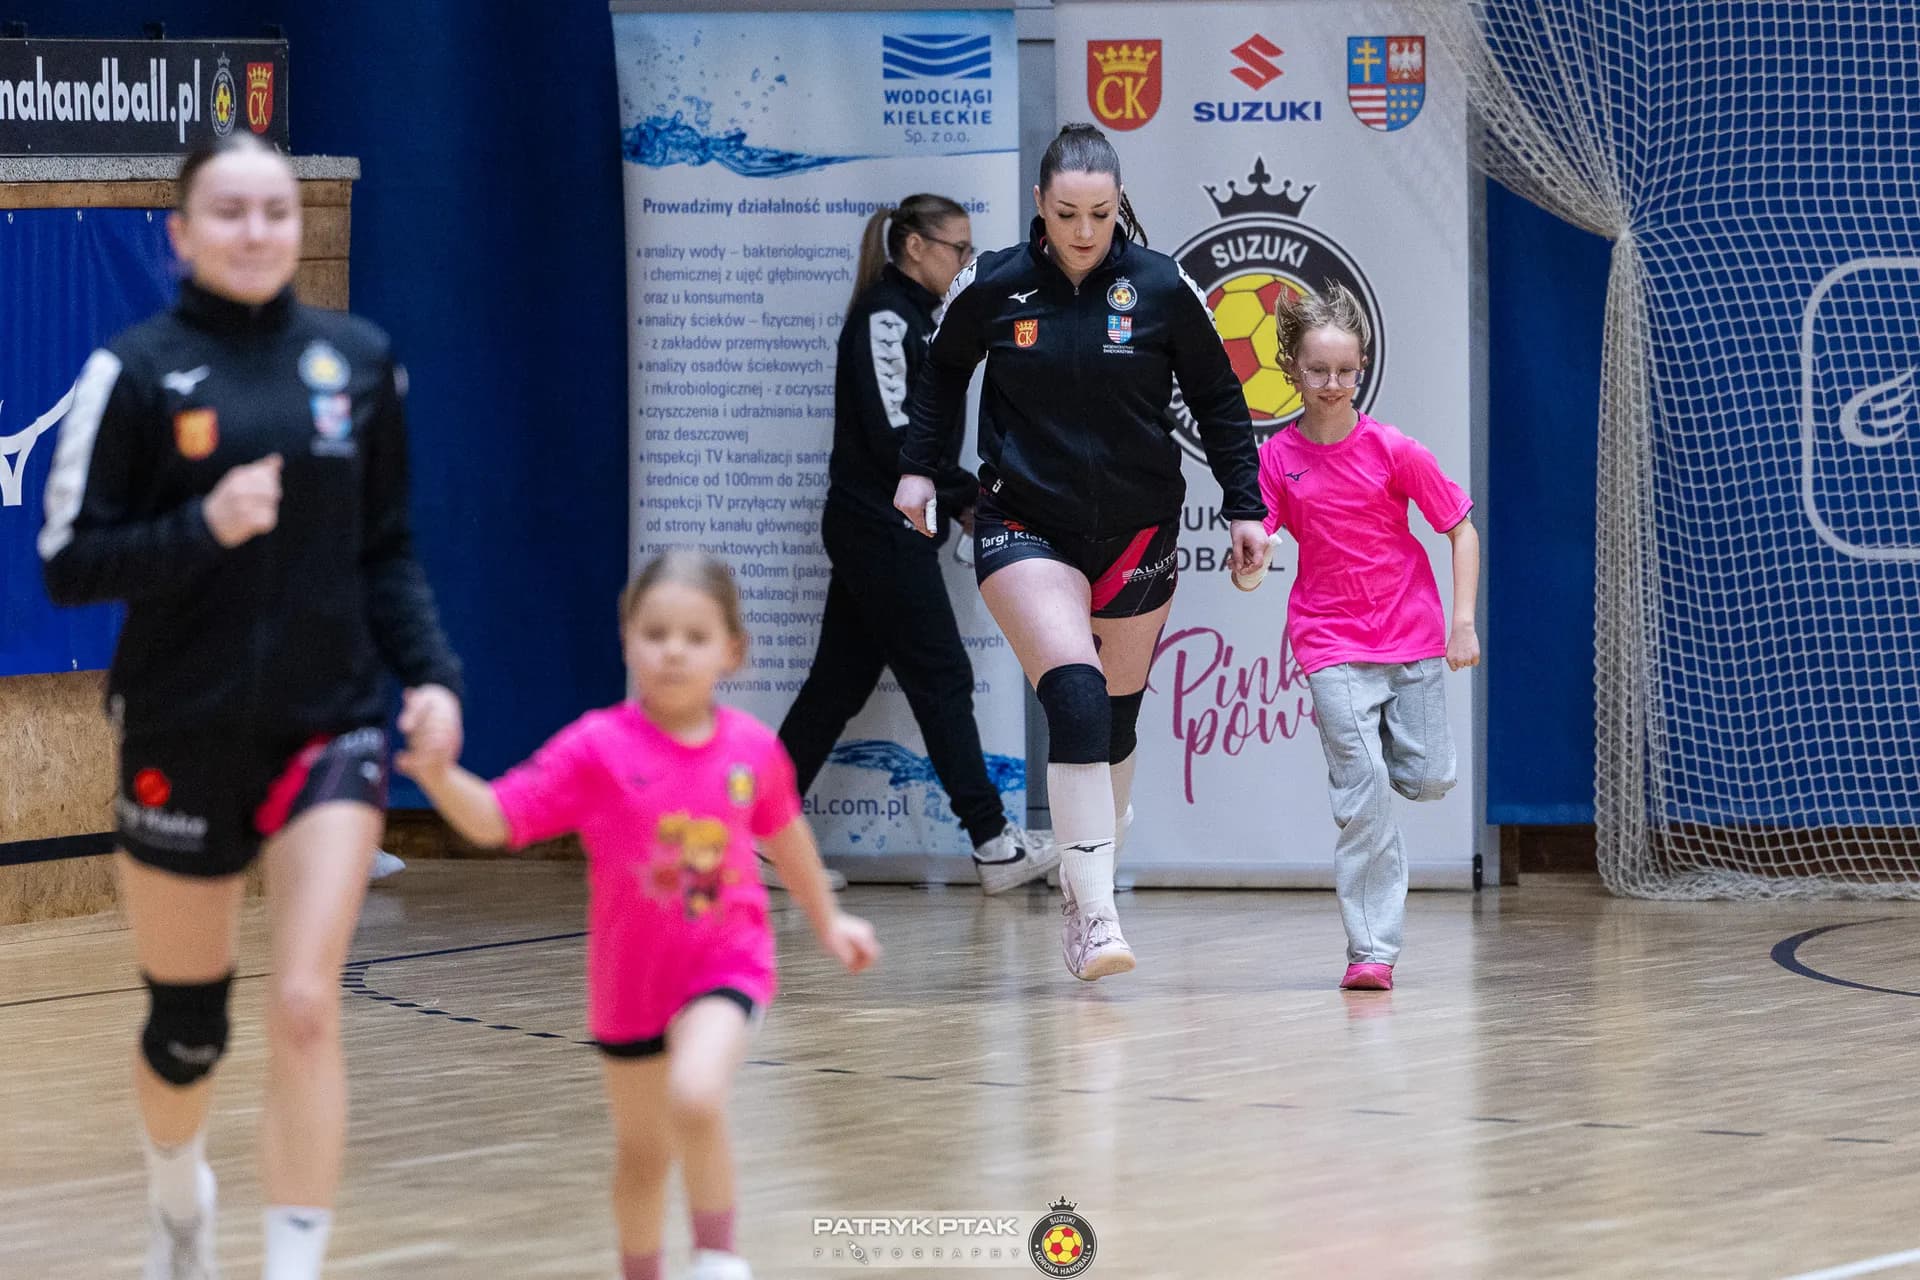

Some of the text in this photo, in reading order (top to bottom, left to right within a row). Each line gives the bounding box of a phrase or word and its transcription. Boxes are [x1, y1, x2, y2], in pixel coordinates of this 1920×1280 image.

[884, 89, 992, 109] WODOCIĄGI
[1096, 76, 1148, 120] CK
[249, 91, 268, 125] CK
[1193, 101, 1322, 122] SUZUKI
[884, 110, 992, 125] KIELECKIE
[904, 129, 970, 145] Sp. z o.o.
[643, 198, 733, 217] Prowadzimy
[738, 198, 821, 214] działalność
[826, 198, 898, 217] usługowa
[644, 244, 685, 261] analizy
[689, 244, 726, 261] wody
[743, 243, 854, 261] bakteriologicznej,
[1211, 235, 1308, 269] SUZUKI
[650, 267, 722, 285] chemicznej
[736, 267, 763, 285] ujęć
[767, 267, 853, 285] głębinowych,
[643, 290, 764, 305] oraz u konsumenta
[645, 313, 687, 329] analizy
[690, 312, 745, 327] ścieków
[762, 312, 815, 329] fizycznej
[827, 312, 847, 327] ch
[661, 336, 722, 351] zakładów
[726, 336, 830, 353] przemysłowych,
[1017, 331, 1033, 346] CK
[645, 358, 687, 374] analizy
[690, 358, 742, 373] osadów
[747, 358, 823, 374] ściekowych
[652, 382, 763, 399] mikrobiologicznej
[785, 385, 836, 399] oczyszc
[646, 406, 719, 420] czyszczenia
[731, 405, 803, 418] udrażniania
[806, 405, 836, 418] kana
[645, 428, 749, 444] oraz deszczowej
[646, 450, 832, 467] inspekcji TV kanalizacji sanit
[646, 472, 831, 487] średnice od 100mm do 2500
[646, 494, 826, 512] inspekcji TV przyłączy włąc
[646, 518, 818, 535] od strony kanału głównego
[1184, 506, 1229, 532] UK
[981, 531, 1009, 550] Targi
[740, 562, 788, 578] 400mm
[738, 586, 827, 604] lokalizacji mie
[758, 635, 773, 647] na
[777, 632, 807, 647] sieci
[751, 655, 785, 669] kania
[1147, 623, 1310, 740] Pink
[802, 795, 910, 819] el.com.pl
